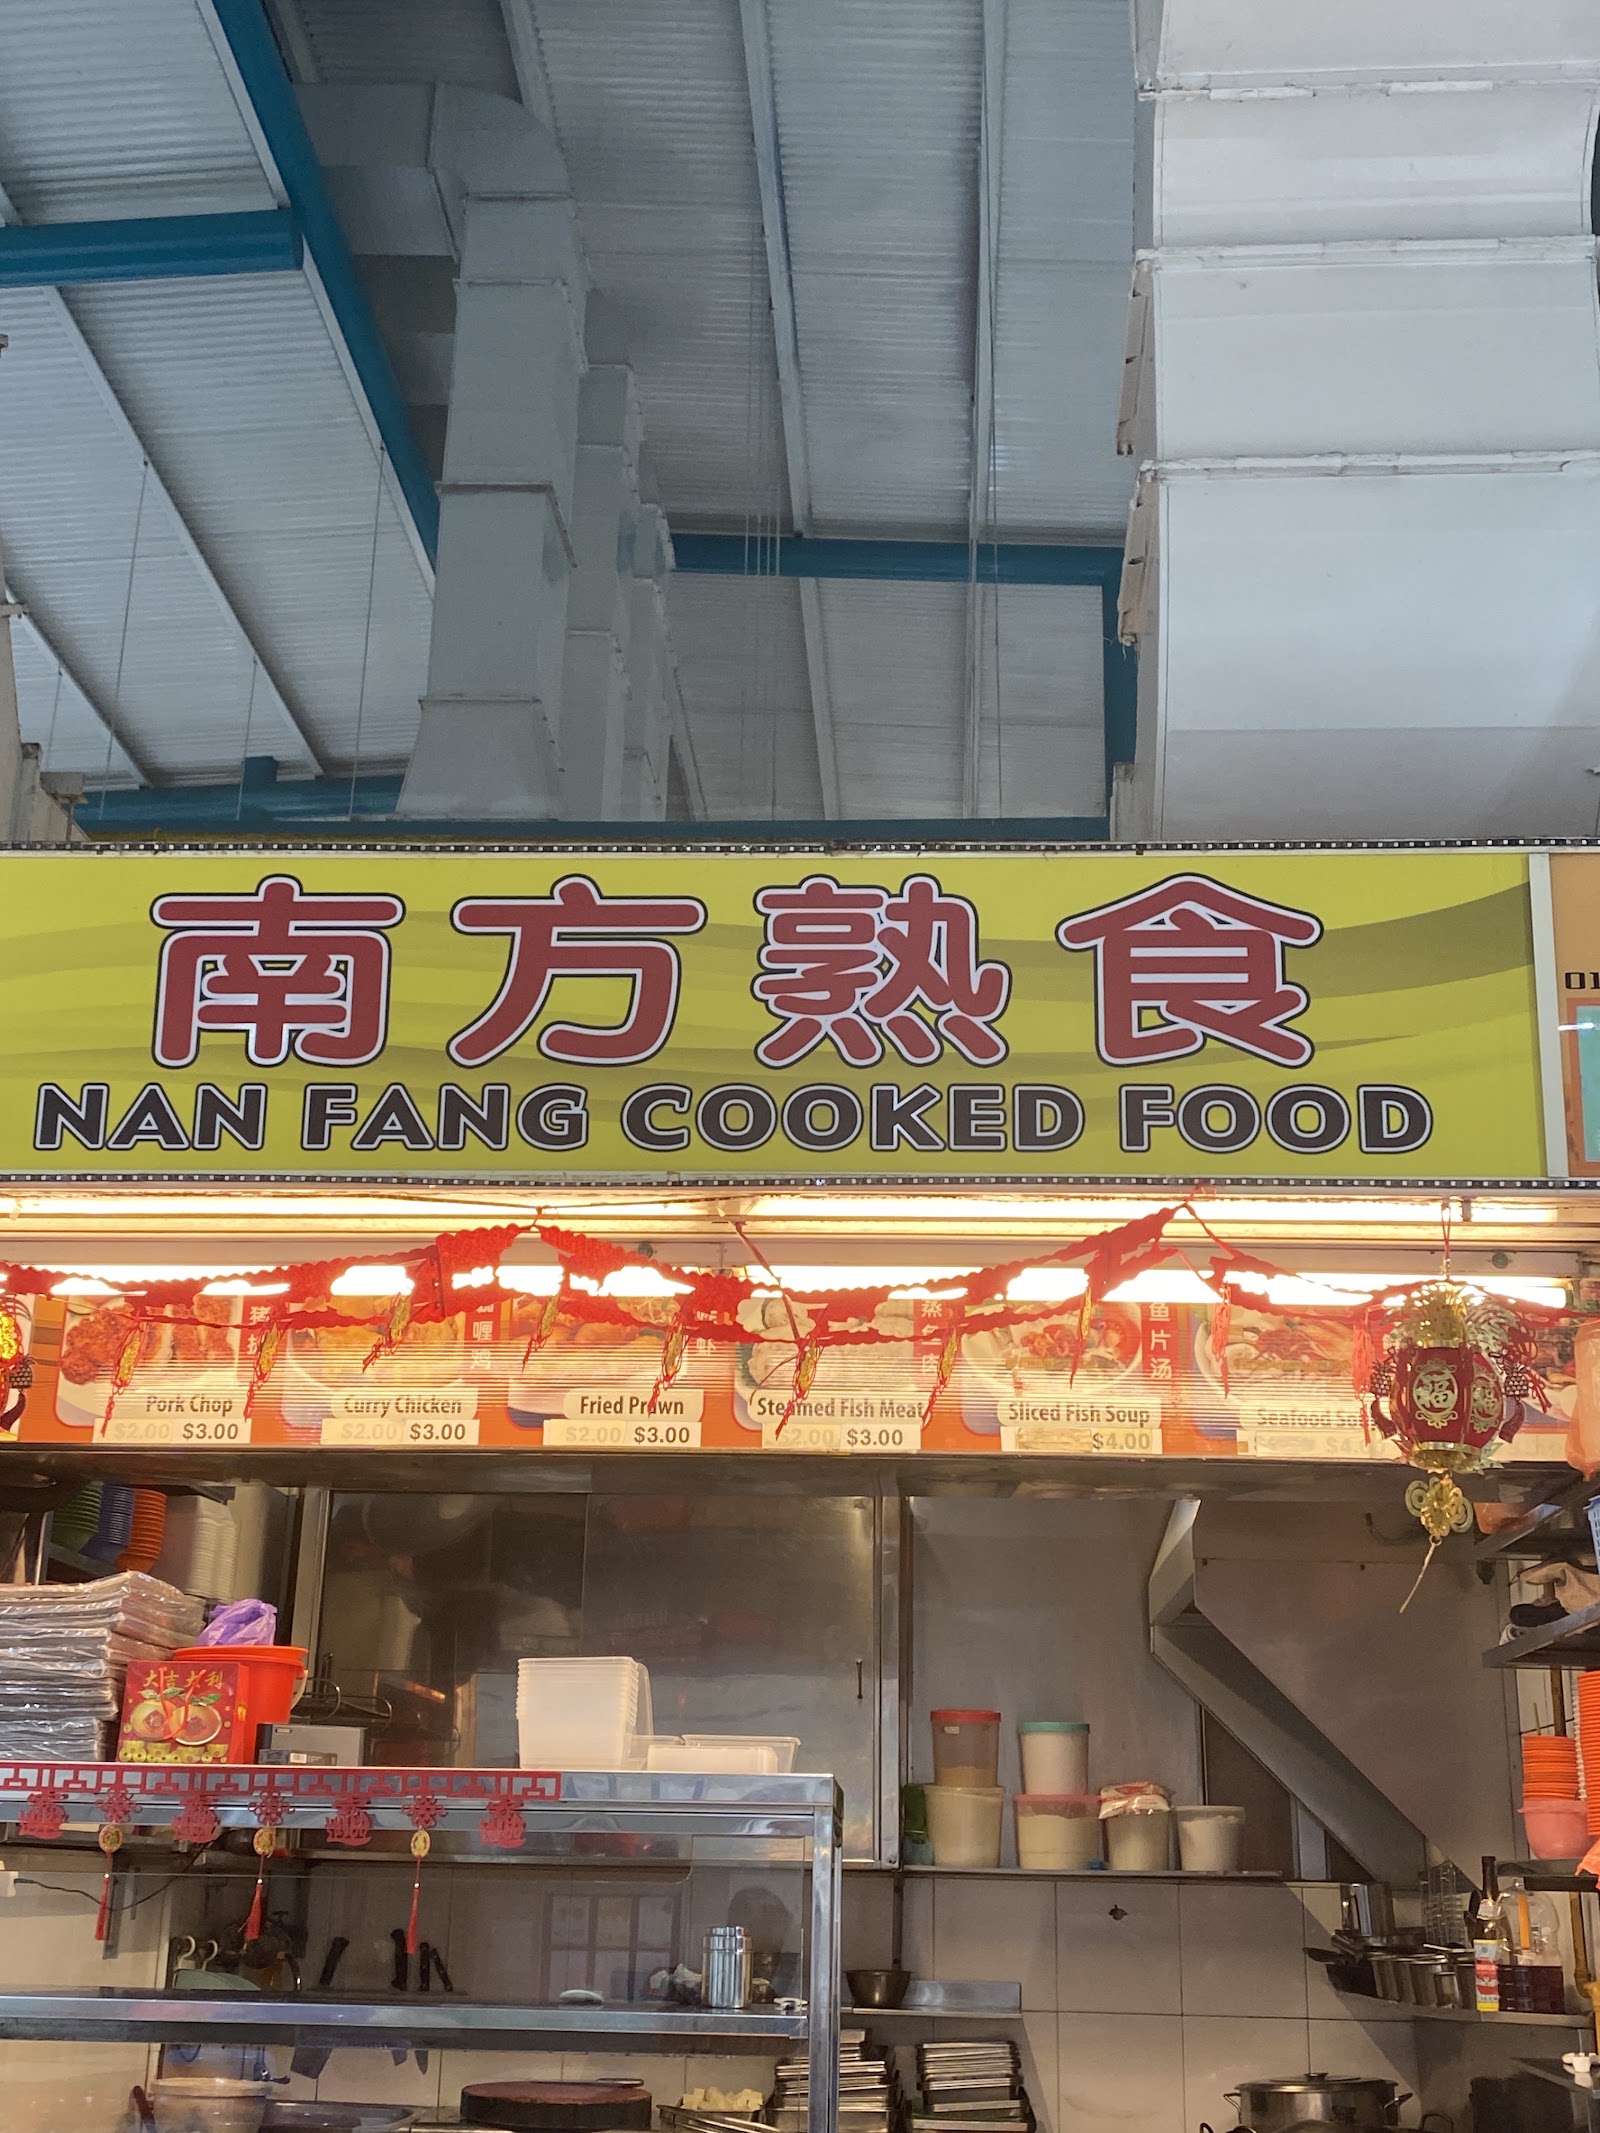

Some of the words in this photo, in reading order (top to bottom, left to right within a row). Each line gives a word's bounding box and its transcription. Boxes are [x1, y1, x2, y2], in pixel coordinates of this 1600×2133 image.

[150, 873, 1323, 1069] 南方熟食
[33, 1083, 268, 1151] NAN
[300, 1083, 590, 1151] FANG
[620, 1083, 1085, 1153] COOKED
[1118, 1083, 1434, 1154] FOOD
[1148, 1302, 1172, 1379] 鱼片汤
[146, 1394, 186, 1412] Pork
[190, 1394, 233, 1417] Chop
[344, 1395, 392, 1418] Curry
[394, 1395, 462, 1413] Chicken
[580, 1396, 623, 1414] Fried
[840, 1399, 875, 1418] Fish
[879, 1401, 924, 1418] Meat
[1009, 1403, 1061, 1421] Sliced
[1066, 1405, 1101, 1422] Fish
[1105, 1406, 1150, 1428] Soup
[1257, 1408, 1331, 1426] Seafood
[182, 1422, 239, 1441] $3.00
[409, 1422, 466, 1441] $3.00
[634, 1425, 690, 1444] $3.00
[847, 1428, 904, 1447] $3.00
[1092, 1431, 1150, 1450] $4.00
